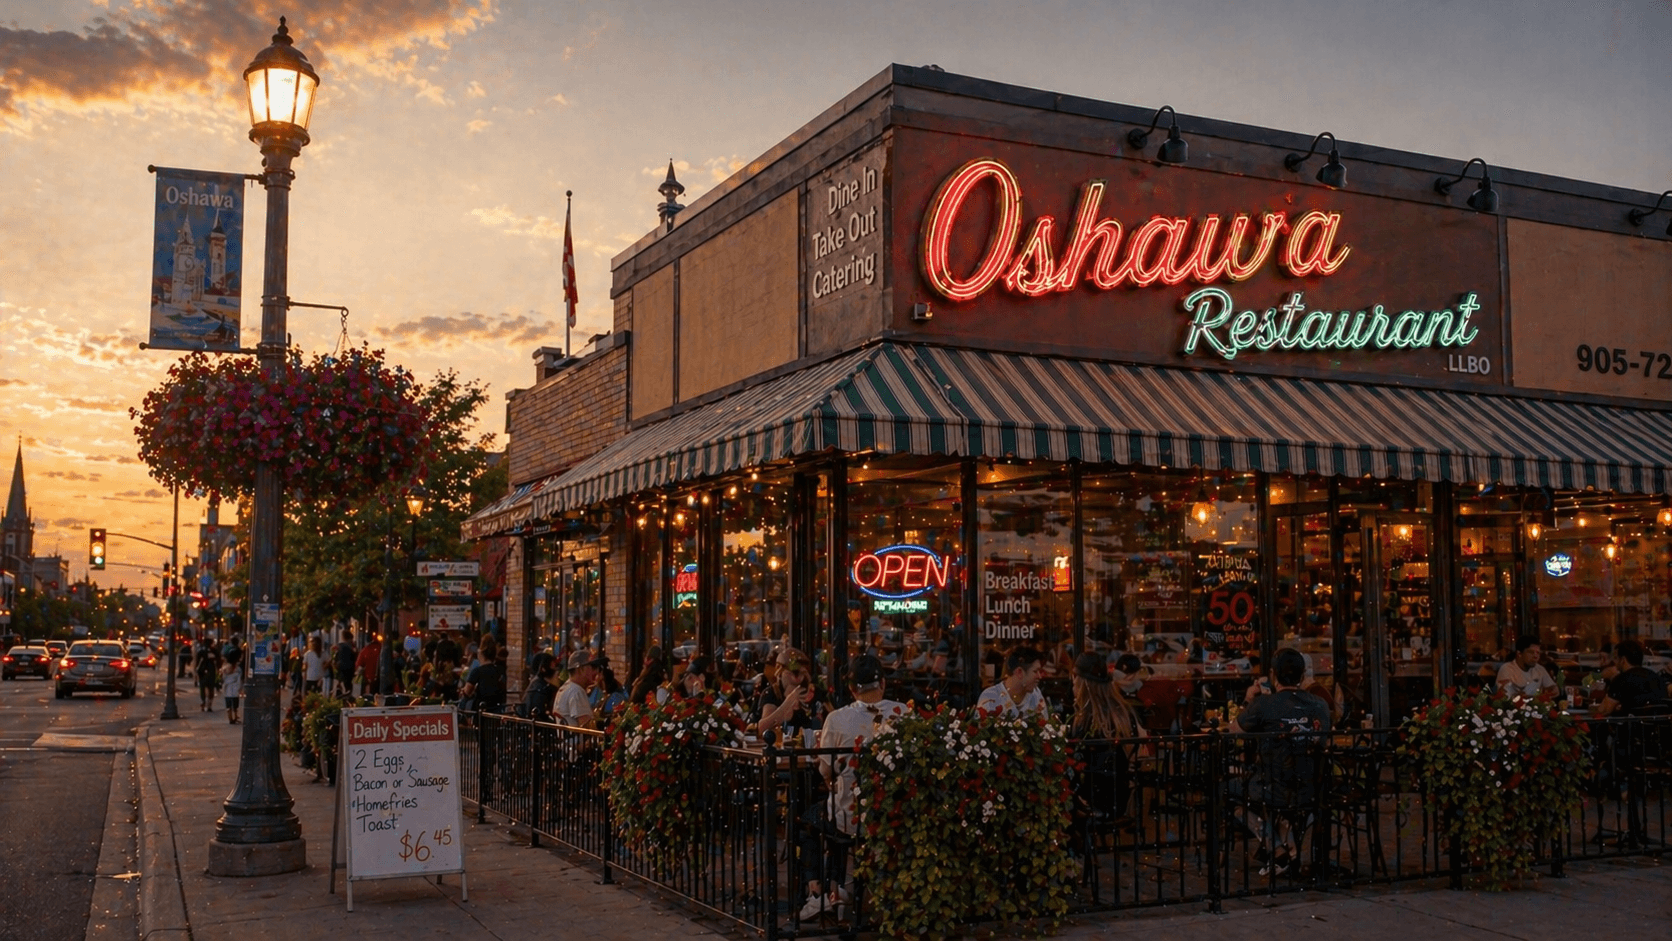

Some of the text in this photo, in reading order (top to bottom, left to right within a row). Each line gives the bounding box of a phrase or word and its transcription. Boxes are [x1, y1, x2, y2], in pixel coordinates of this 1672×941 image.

[165, 184, 234, 209] Oshawa
[828, 166, 876, 215] Dine In
[812, 205, 876, 261] Take Out
[919, 157, 1352, 300] Oshawa
[812, 252, 875, 299] Catering
[1184, 287, 1481, 359] Restaurant
[1448, 354, 1490, 375] LLBO
[1576, 344, 1672, 379] 905-72
[854, 554, 950, 588] OPEN
[985, 571, 1054, 590] Breakfast
[985, 594, 1031, 614] Lunch
[1207, 591, 1255, 625] 50
[985, 620, 1036, 639] Dinner
[353, 720, 449, 742] Daily Specials
[354, 749, 367, 770] 2
[353, 769, 450, 793] Bacon or Sausage
[355, 792, 418, 813] Homefries
[356, 813, 398, 833] Toast
